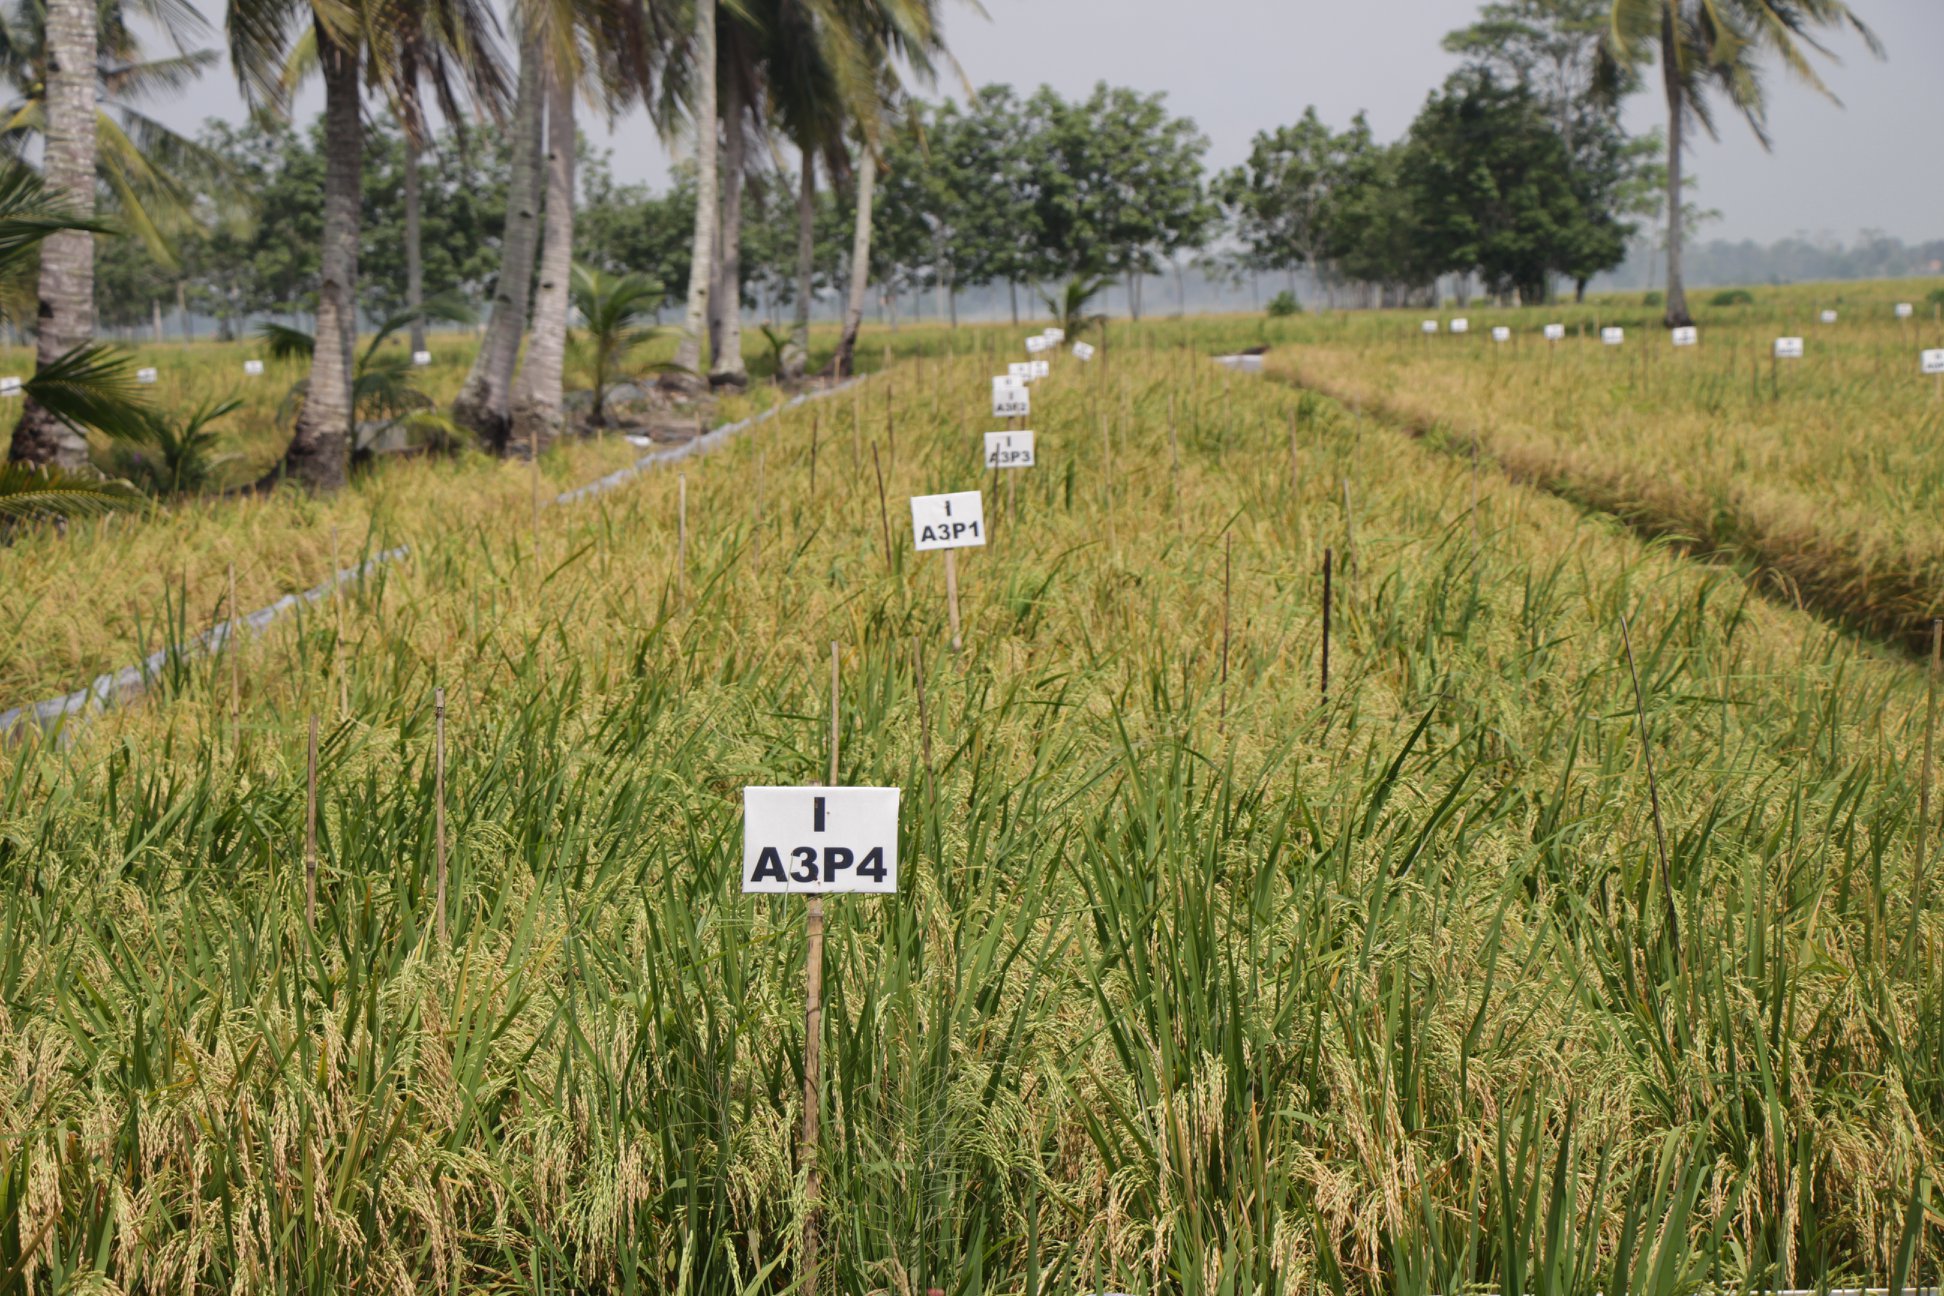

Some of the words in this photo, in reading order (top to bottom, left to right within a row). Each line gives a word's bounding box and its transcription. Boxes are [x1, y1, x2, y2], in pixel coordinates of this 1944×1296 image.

[989, 451, 1031, 463] A3P3
[945, 500, 952, 516] I
[921, 520, 979, 543] A3P1
[814, 797, 825, 832] I
[750, 846, 887, 882] A3P4
